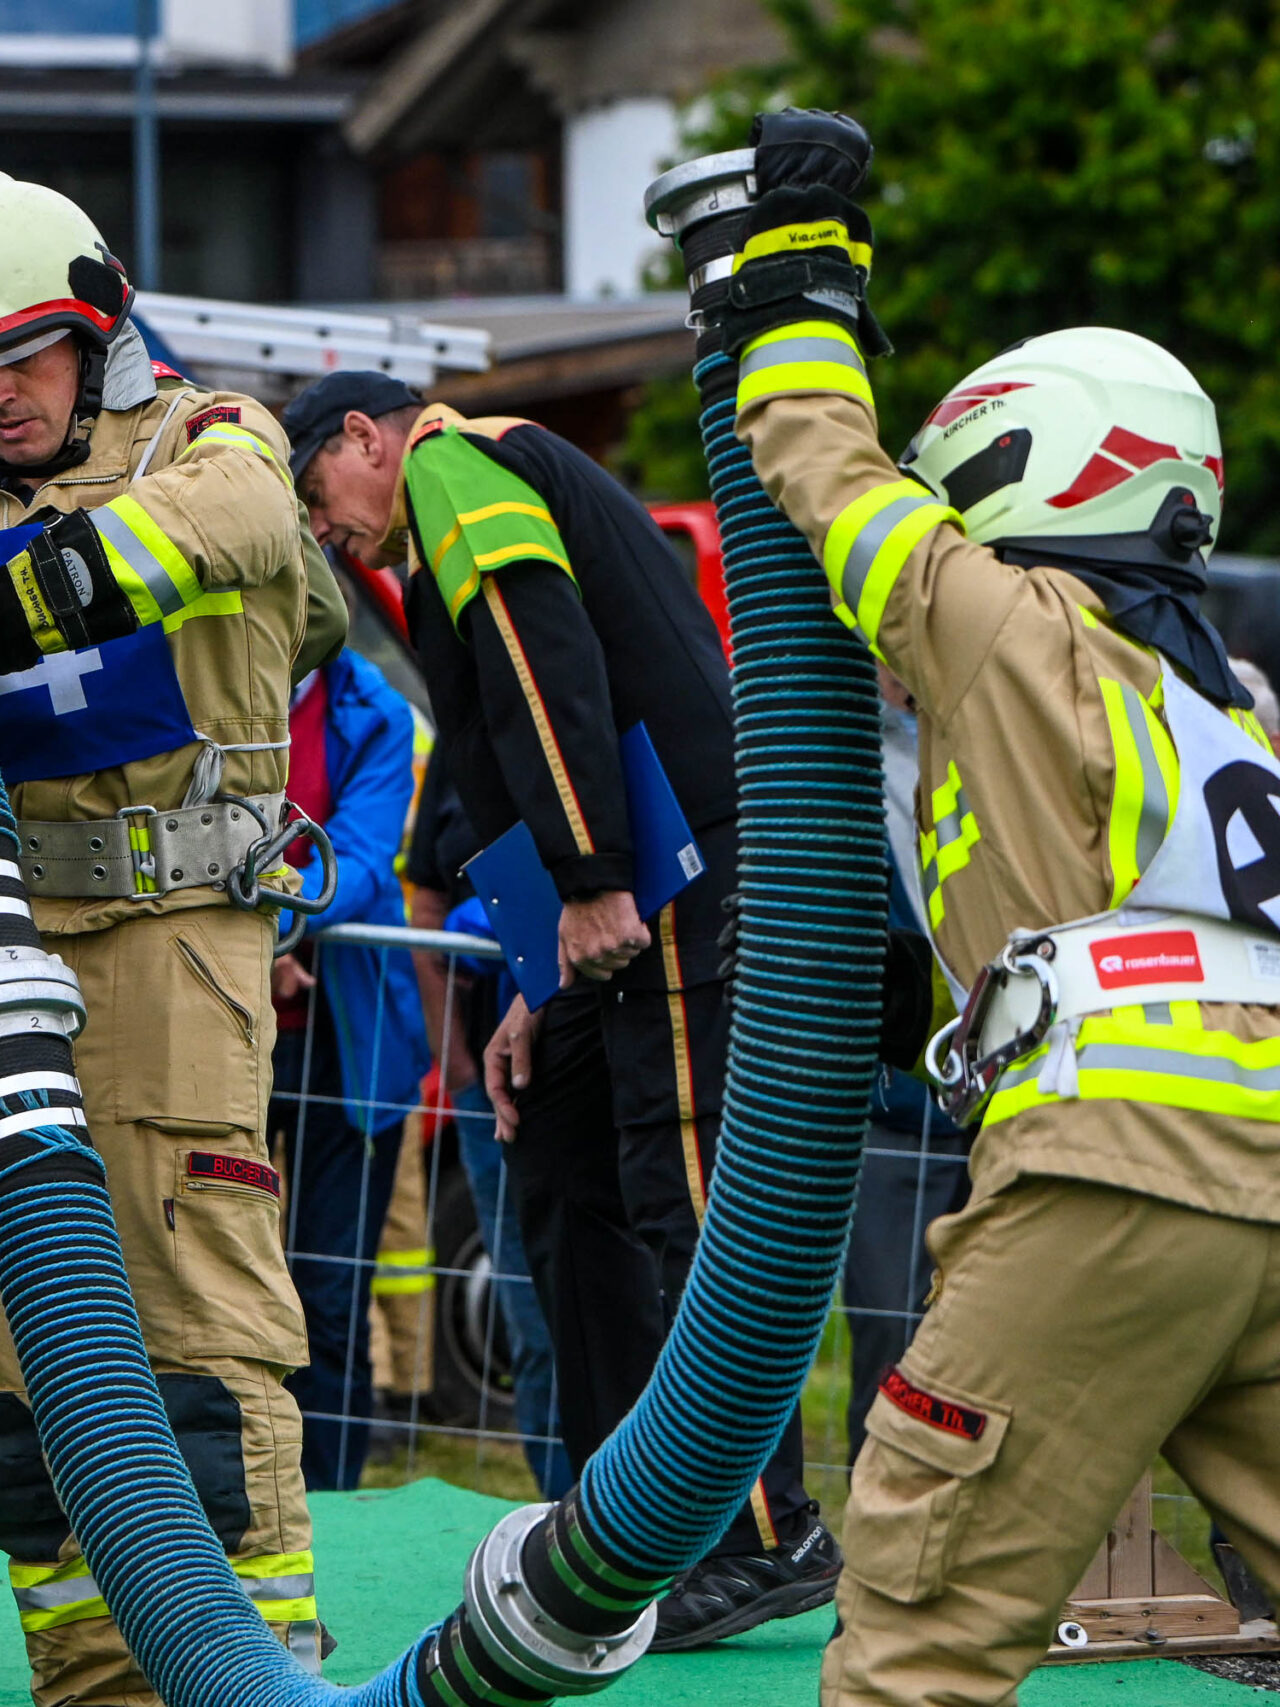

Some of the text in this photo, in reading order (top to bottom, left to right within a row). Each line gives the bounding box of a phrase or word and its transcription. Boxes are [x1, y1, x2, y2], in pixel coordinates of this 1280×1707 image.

[942, 406, 988, 440] KIRCHER
[62, 551, 86, 596] PATRON
[1125, 953, 1196, 970] rosenbauer
[30, 1016, 42, 1029] 2
[214, 1158, 260, 1181] BUCHER
[791, 1525, 824, 1563] salomon
